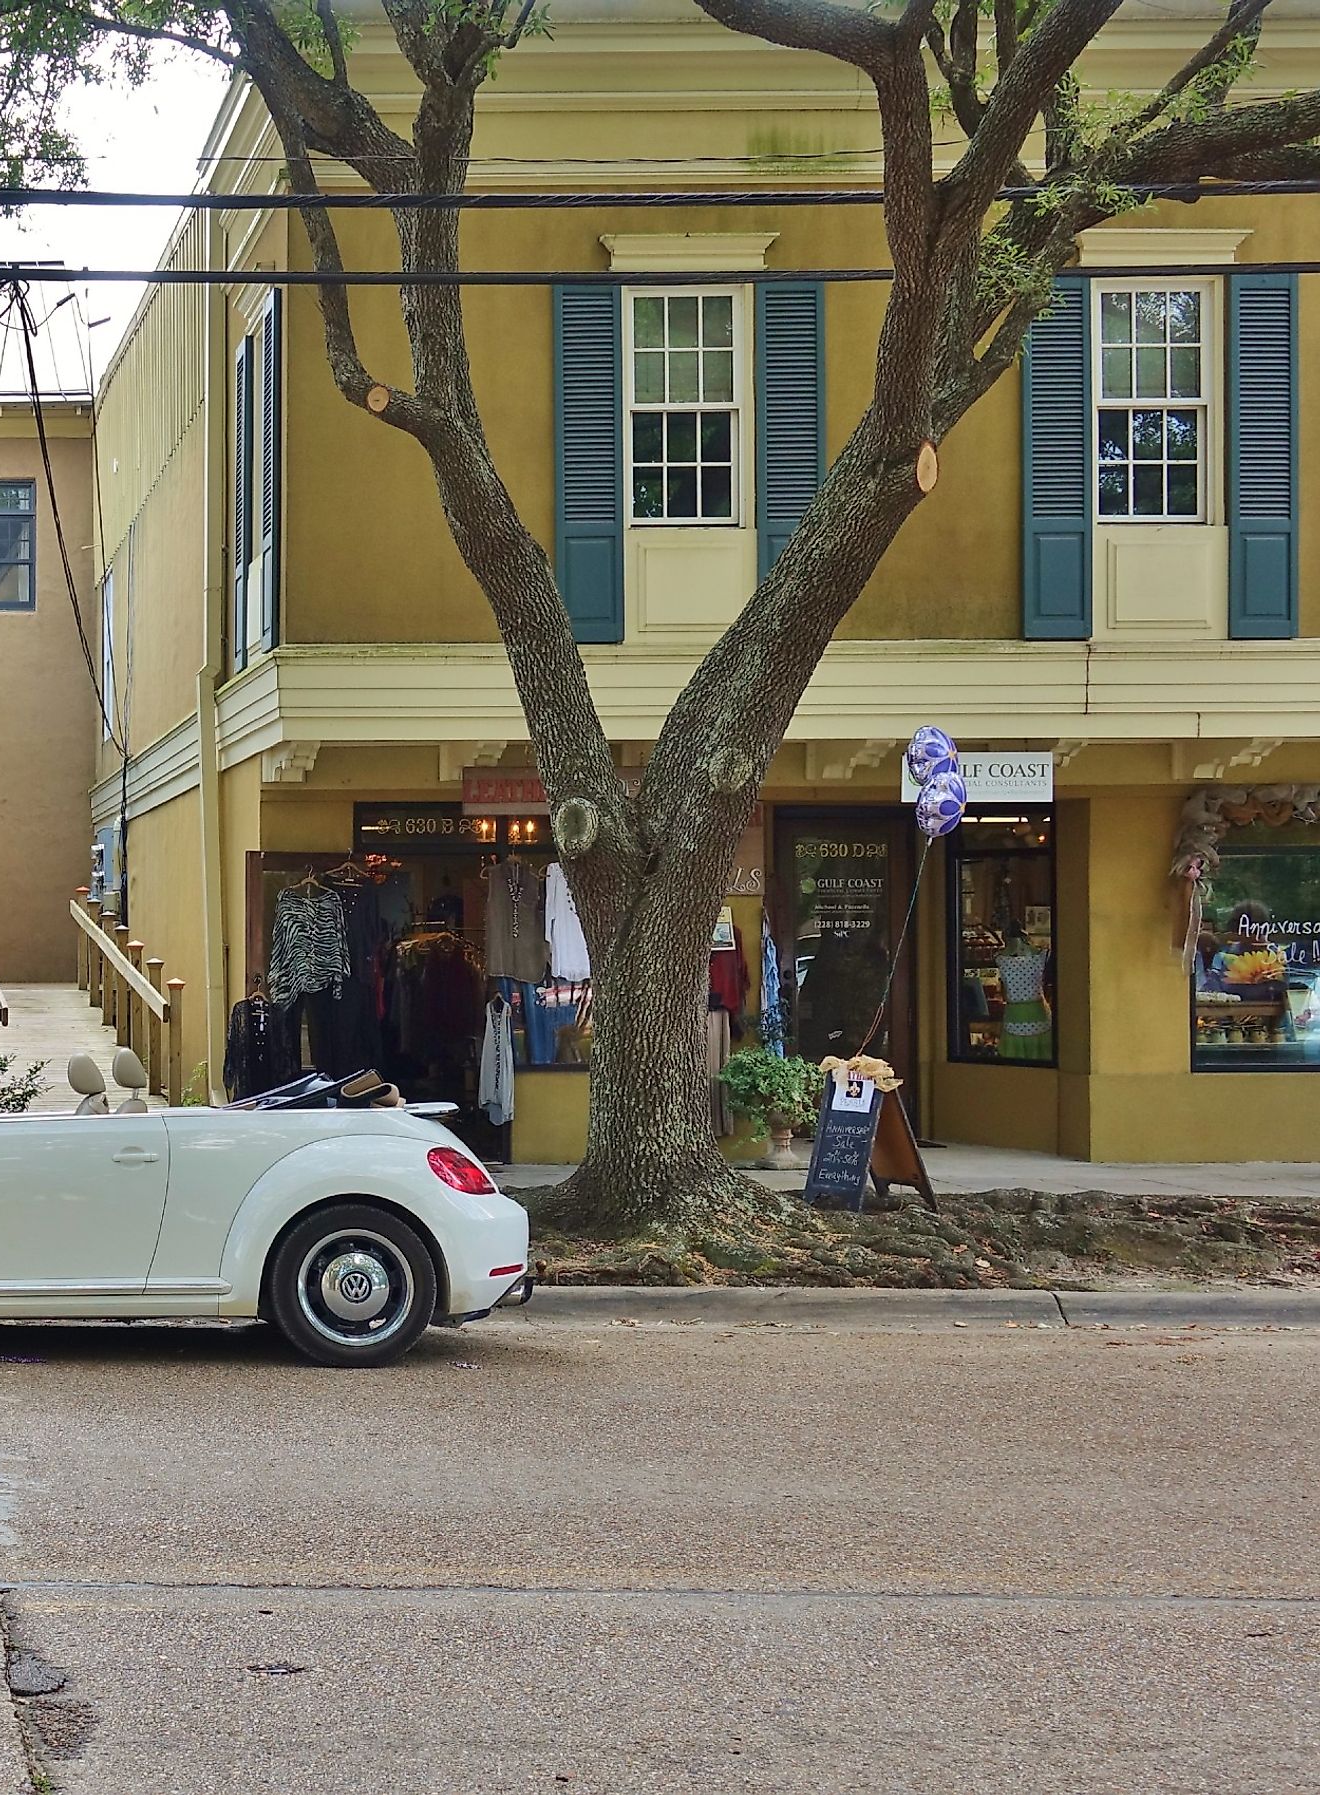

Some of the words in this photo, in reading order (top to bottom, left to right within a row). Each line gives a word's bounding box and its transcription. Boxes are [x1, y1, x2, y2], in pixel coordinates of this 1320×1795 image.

[957, 763, 982, 778] LF
[988, 763, 1049, 778] COAST
[405, 818, 437, 834] 630
[819, 843, 849, 858] 630
[852, 843, 865, 858] D
[817, 878, 846, 889] GULF
[847, 878, 883, 889] COAST
[1261, 941, 1308, 965] Sale
[832, 1136, 855, 1149] Sale
[342, 1273, 369, 1300] VW
